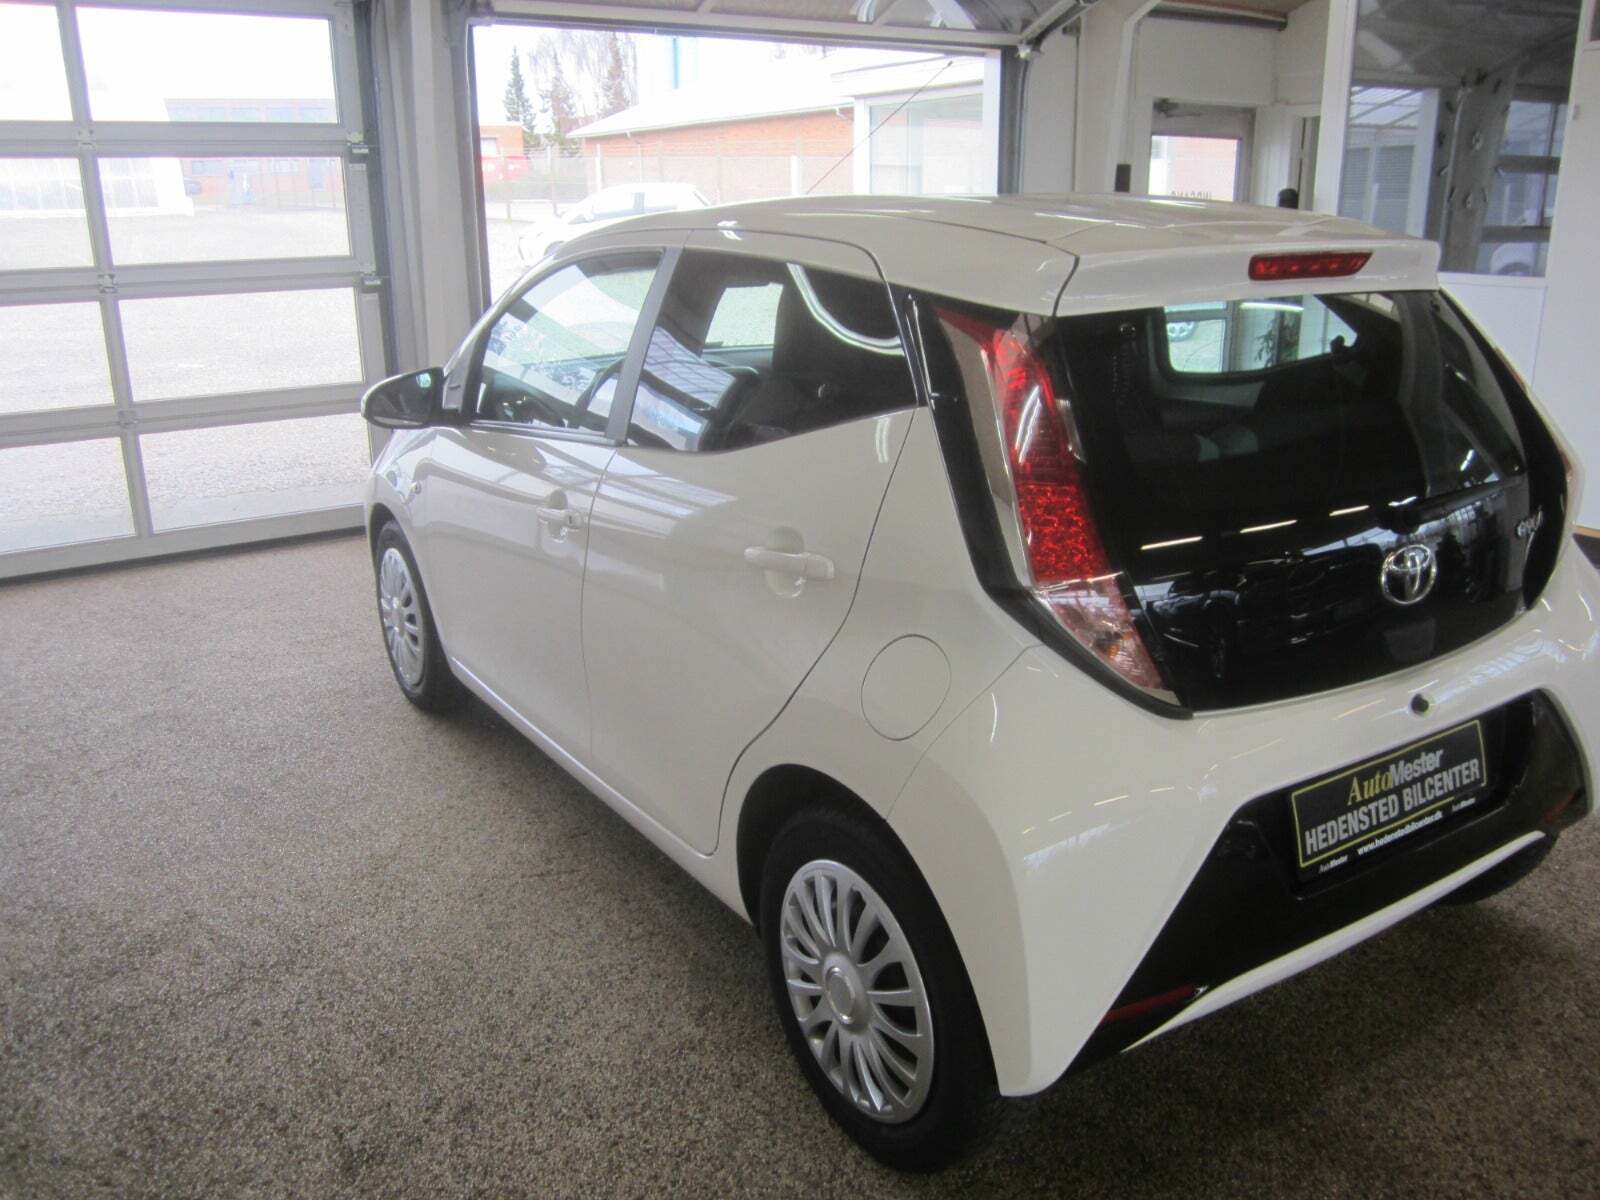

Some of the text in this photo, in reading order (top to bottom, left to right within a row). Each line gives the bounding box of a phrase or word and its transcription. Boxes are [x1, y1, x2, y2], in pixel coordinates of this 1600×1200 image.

[1304, 758, 1480, 855] HEDENSTED BILCENTER
[1347, 750, 1443, 806] AutoMester
